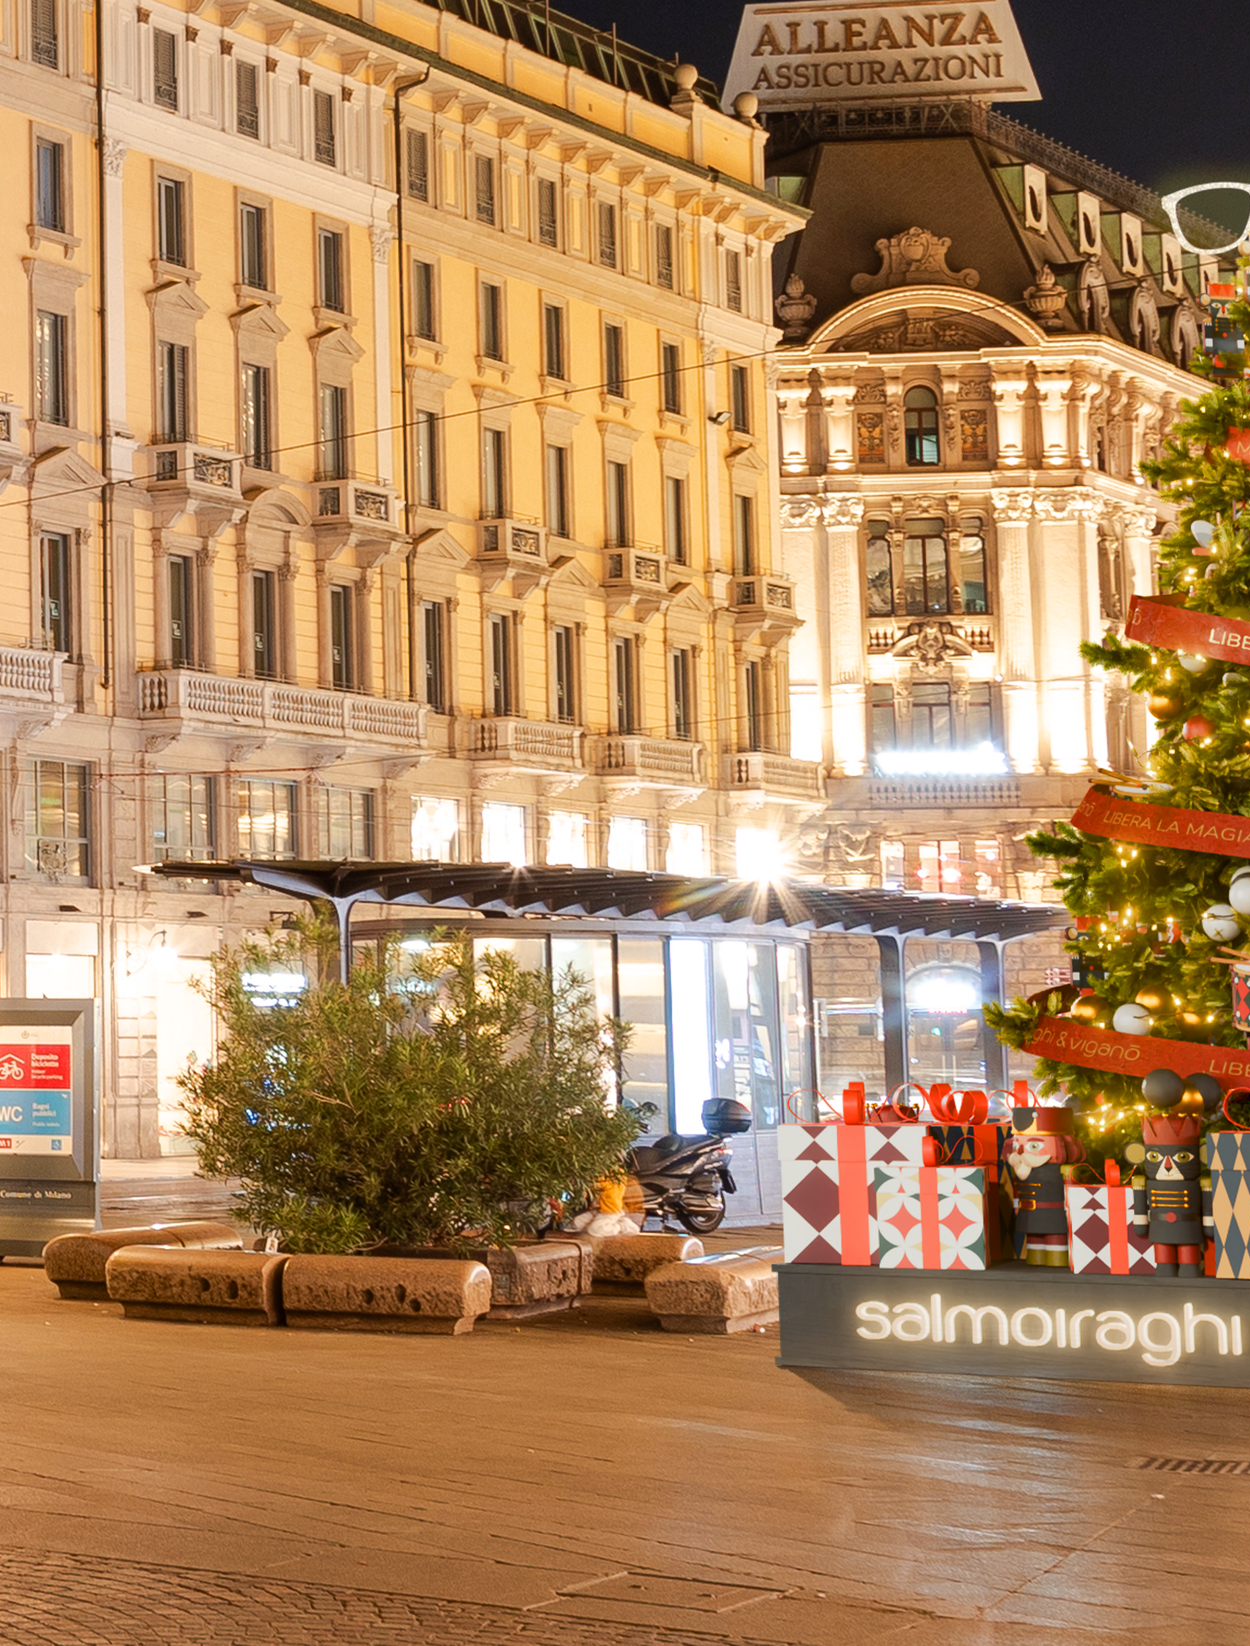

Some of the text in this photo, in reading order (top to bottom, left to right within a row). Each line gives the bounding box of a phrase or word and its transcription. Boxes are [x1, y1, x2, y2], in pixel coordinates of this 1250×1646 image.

[751, 11, 1003, 57] ALLEANZA
[752, 53, 1004, 91] ASSICURAZIONI
[1103, 810, 1151, 830] LIBERA
[1156, 820, 1180, 834] LA
[1056, 1031, 1067, 1048] &
[0, 1105, 23, 1122] WC
[0, 1189, 73, 1199] Comune di Milano
[854, 1293, 1243, 1368] salmoiraghi
